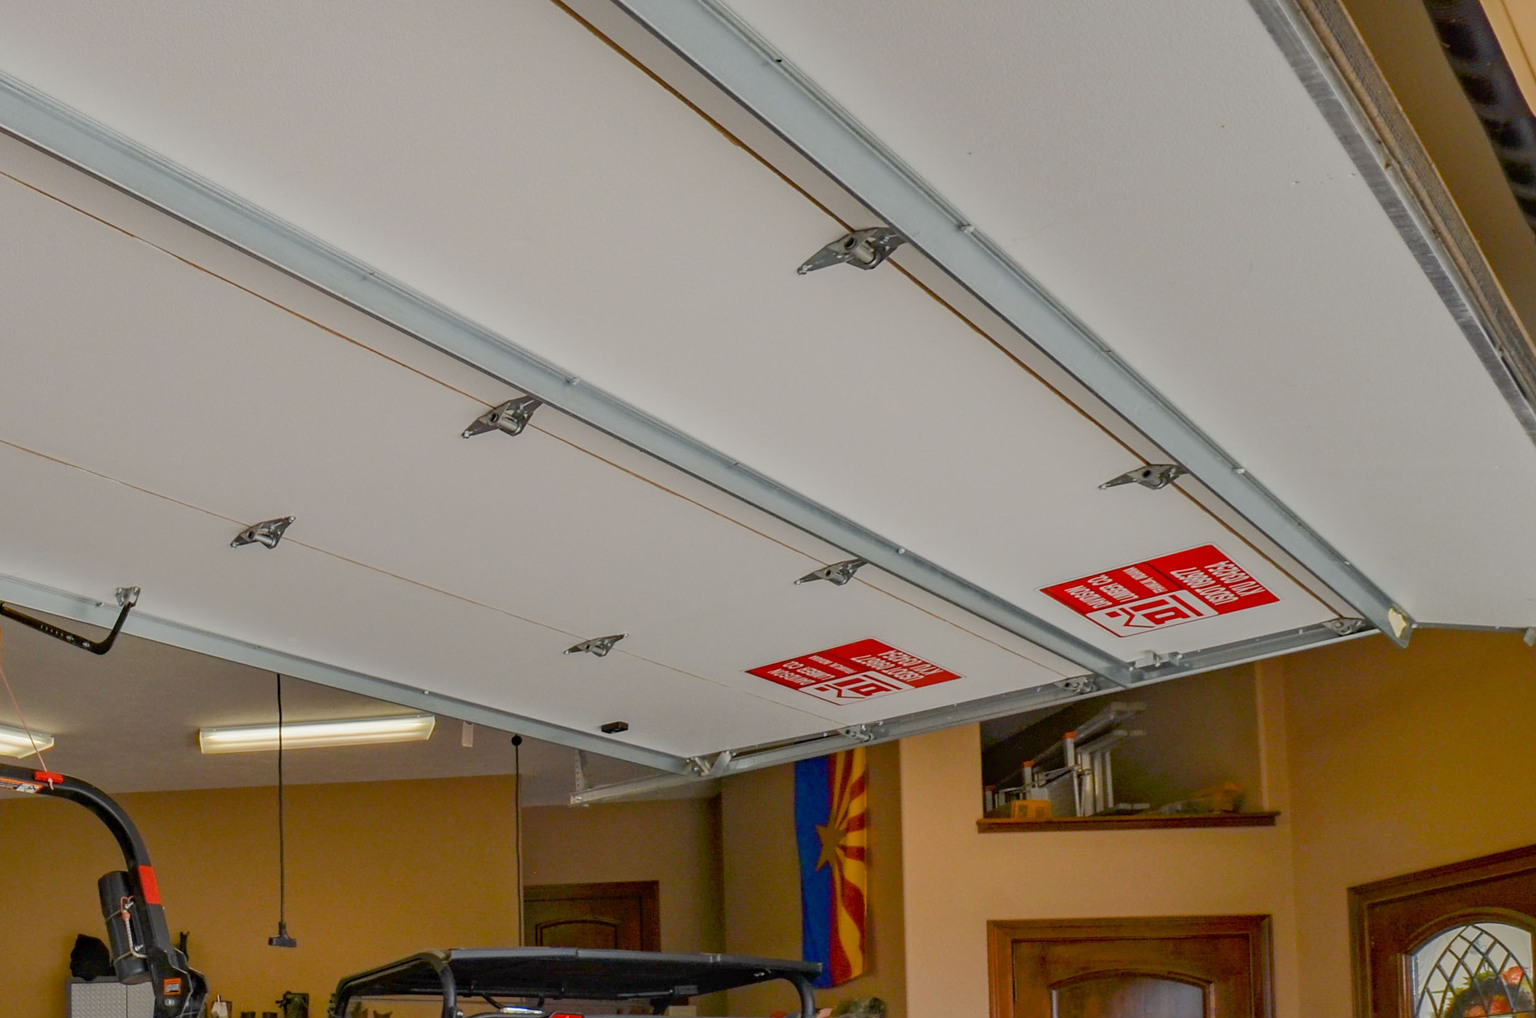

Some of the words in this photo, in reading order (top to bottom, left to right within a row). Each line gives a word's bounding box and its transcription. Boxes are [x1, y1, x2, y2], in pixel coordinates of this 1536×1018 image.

[1064, 585, 1112, 609] DAVIDSON
[1099, 582, 1138, 602] LUMBER
[1196, 585, 1239, 605] USDOT
[1234, 580, 1265, 597] KYU
[797, 667, 835, 681] LUMBER
